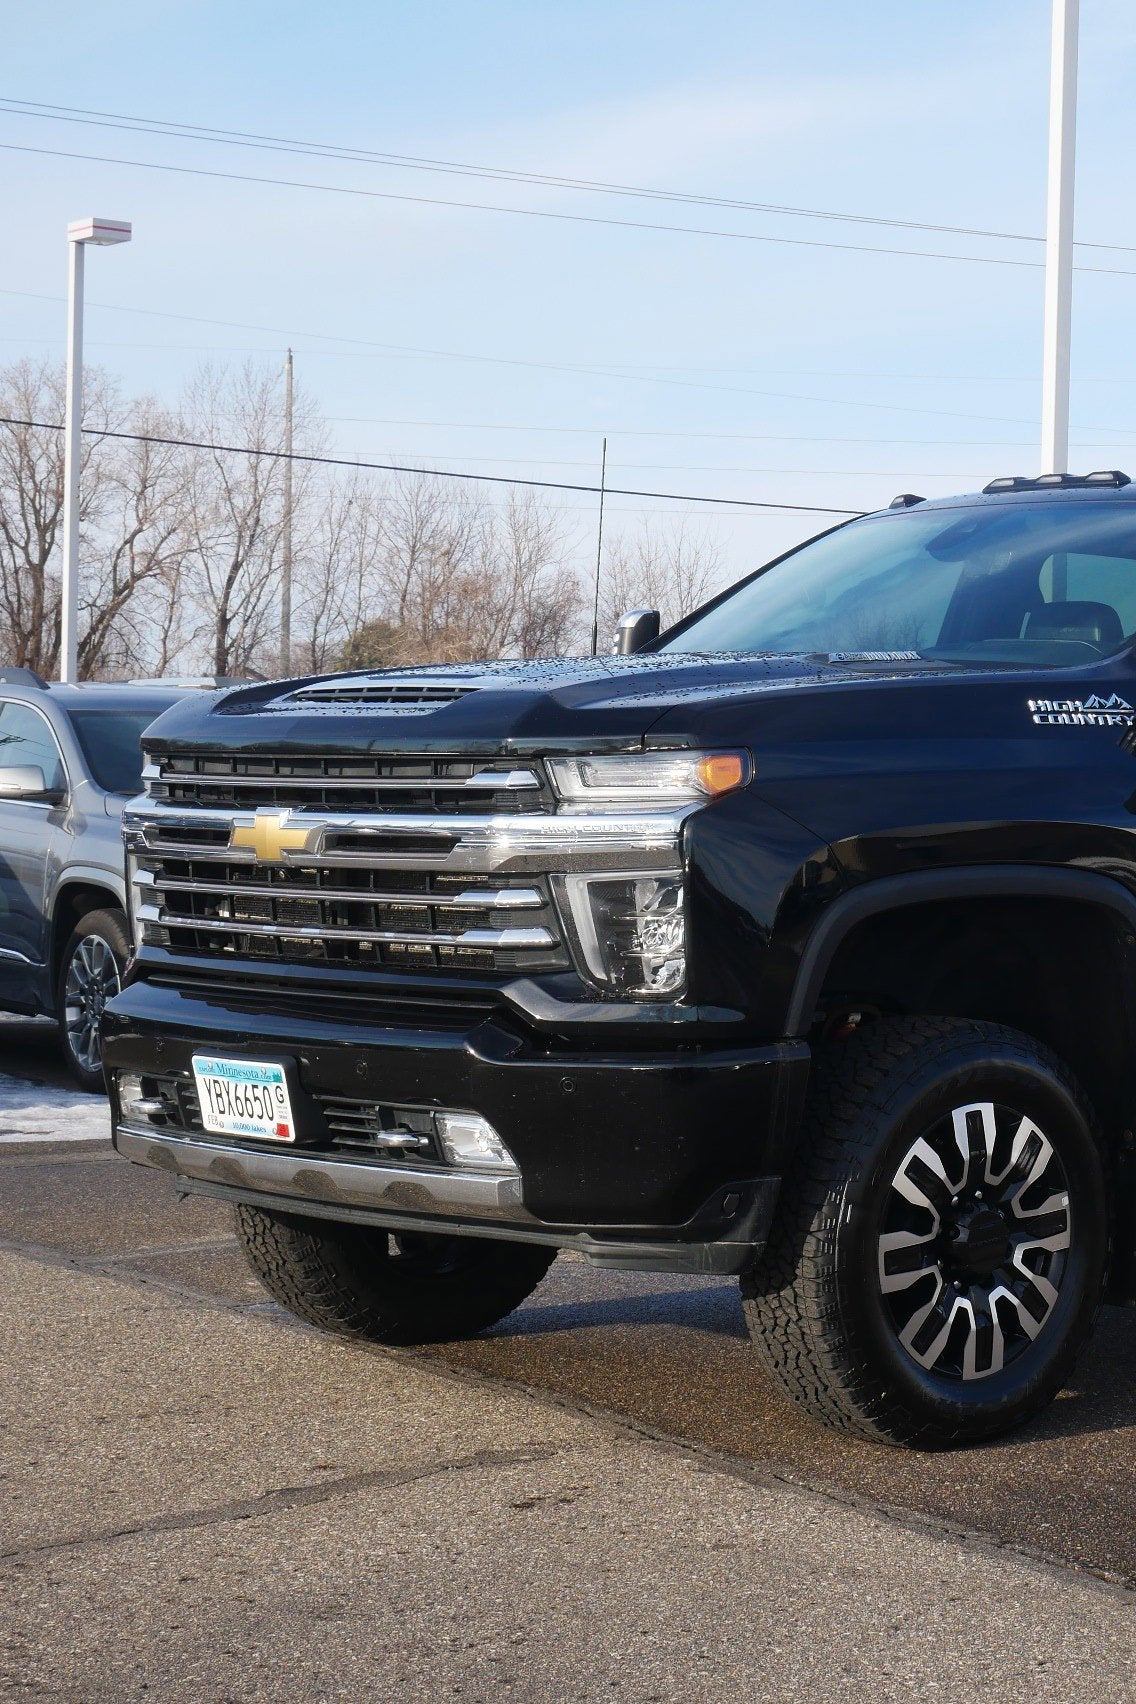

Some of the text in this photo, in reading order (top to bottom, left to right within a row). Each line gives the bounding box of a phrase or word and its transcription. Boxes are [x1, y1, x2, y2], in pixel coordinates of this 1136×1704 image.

[1028, 699, 1083, 712] HIGH
[1033, 713, 1134, 726] COUNTRY
[215, 1062, 260, 1079] Minnesota
[203, 1077, 274, 1122] YBX6650
[275, 1085, 285, 1104] G
